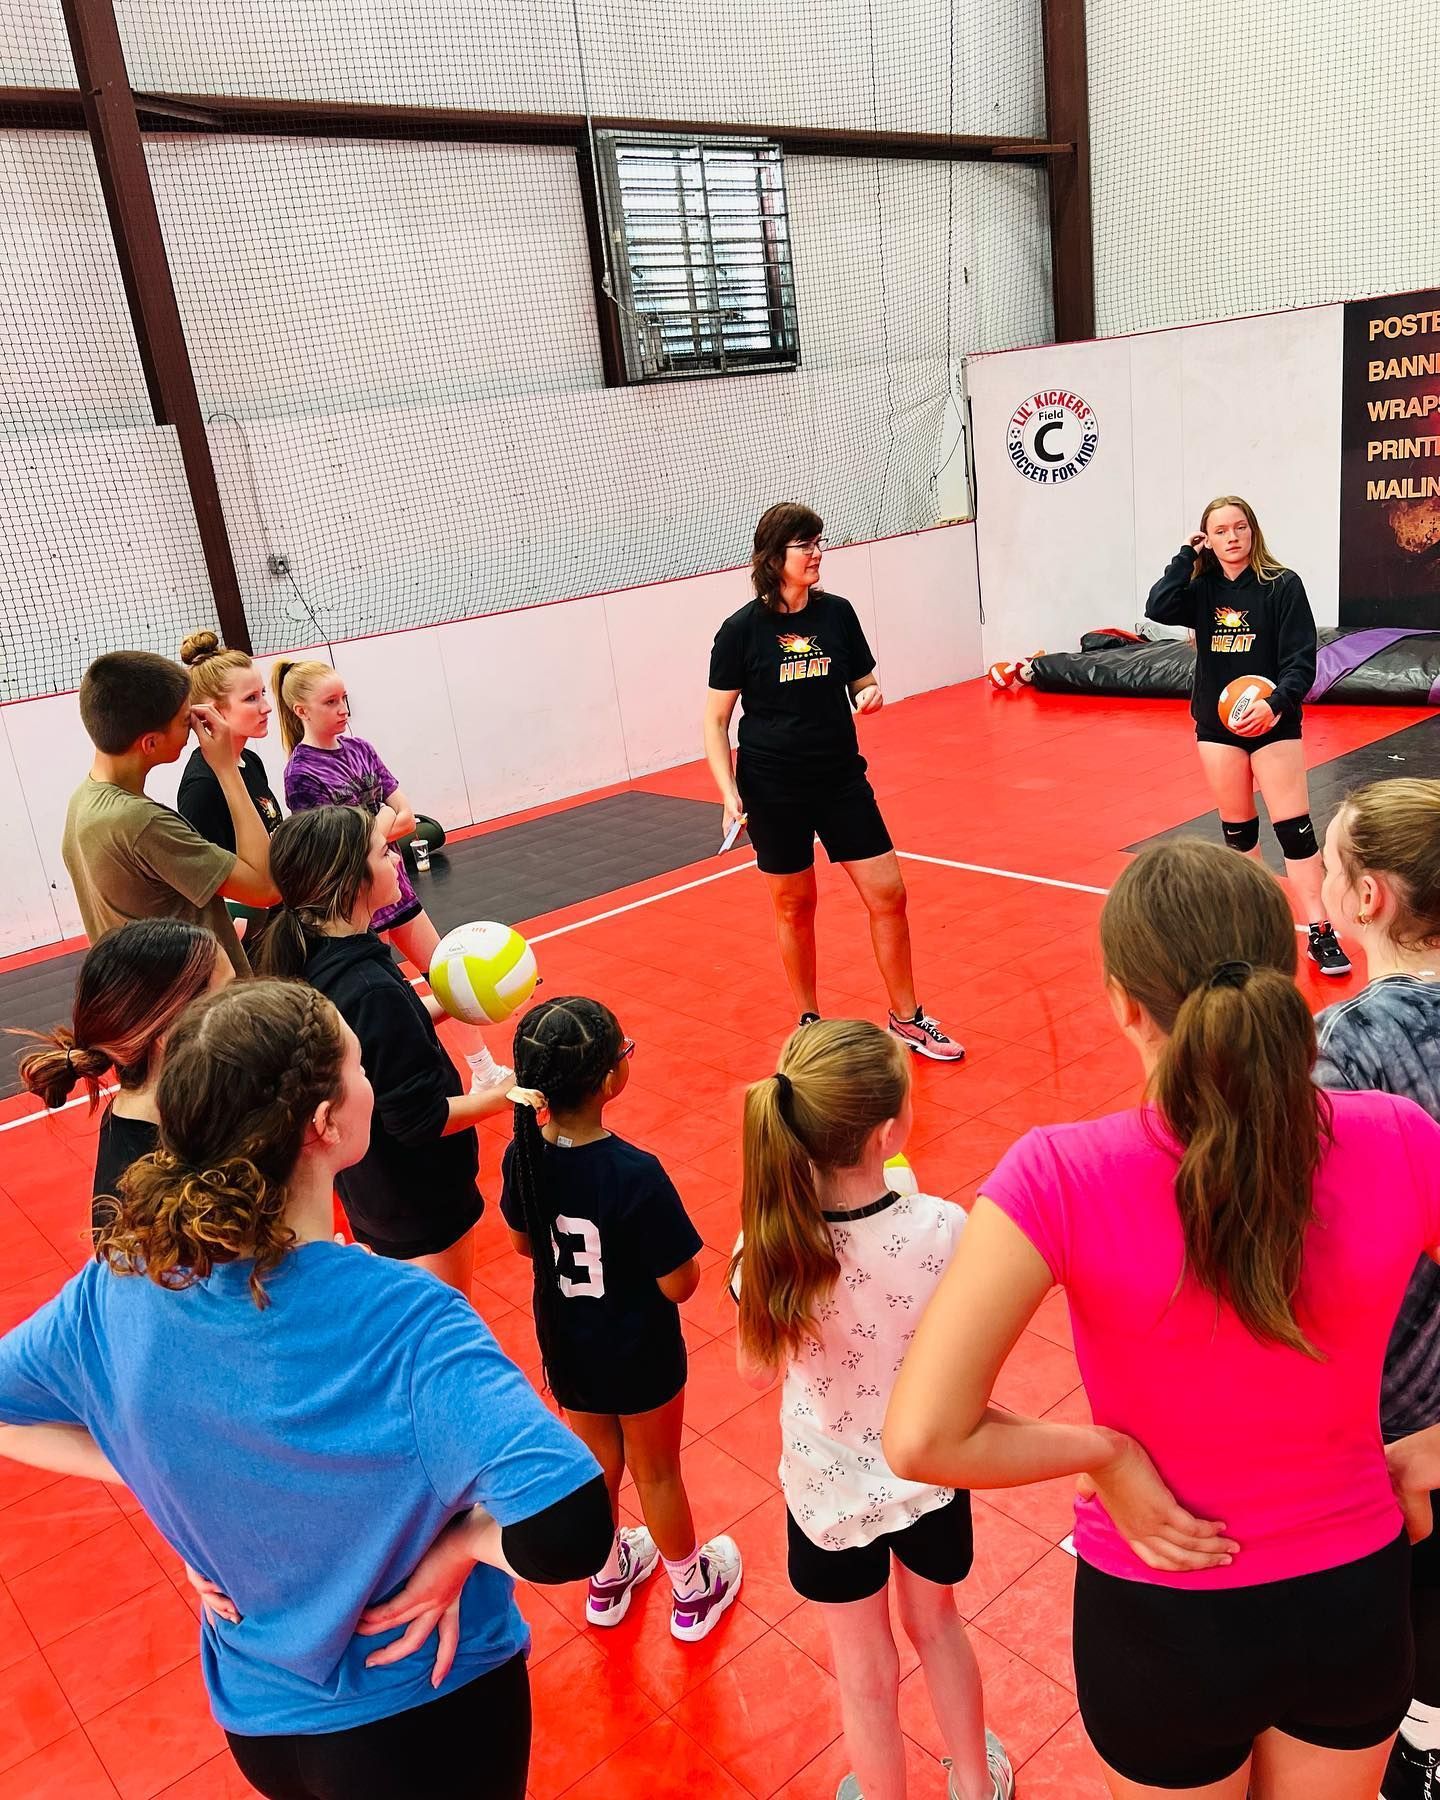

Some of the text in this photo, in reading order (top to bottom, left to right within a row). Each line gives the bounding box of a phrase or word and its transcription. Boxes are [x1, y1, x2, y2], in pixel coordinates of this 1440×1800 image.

[1369, 310, 1440, 341] POSTE
[1033, 391, 1091, 420] KICKERS
[1038, 409, 1064, 421] Field
[1367, 395, 1440, 422] WRAP
[1034, 421, 1065, 463] C
[1009, 434, 1098, 483] SOCCER FOR KIDS
[1211, 633, 1257, 653] HEAT
[779, 657, 832, 683] HEAT
